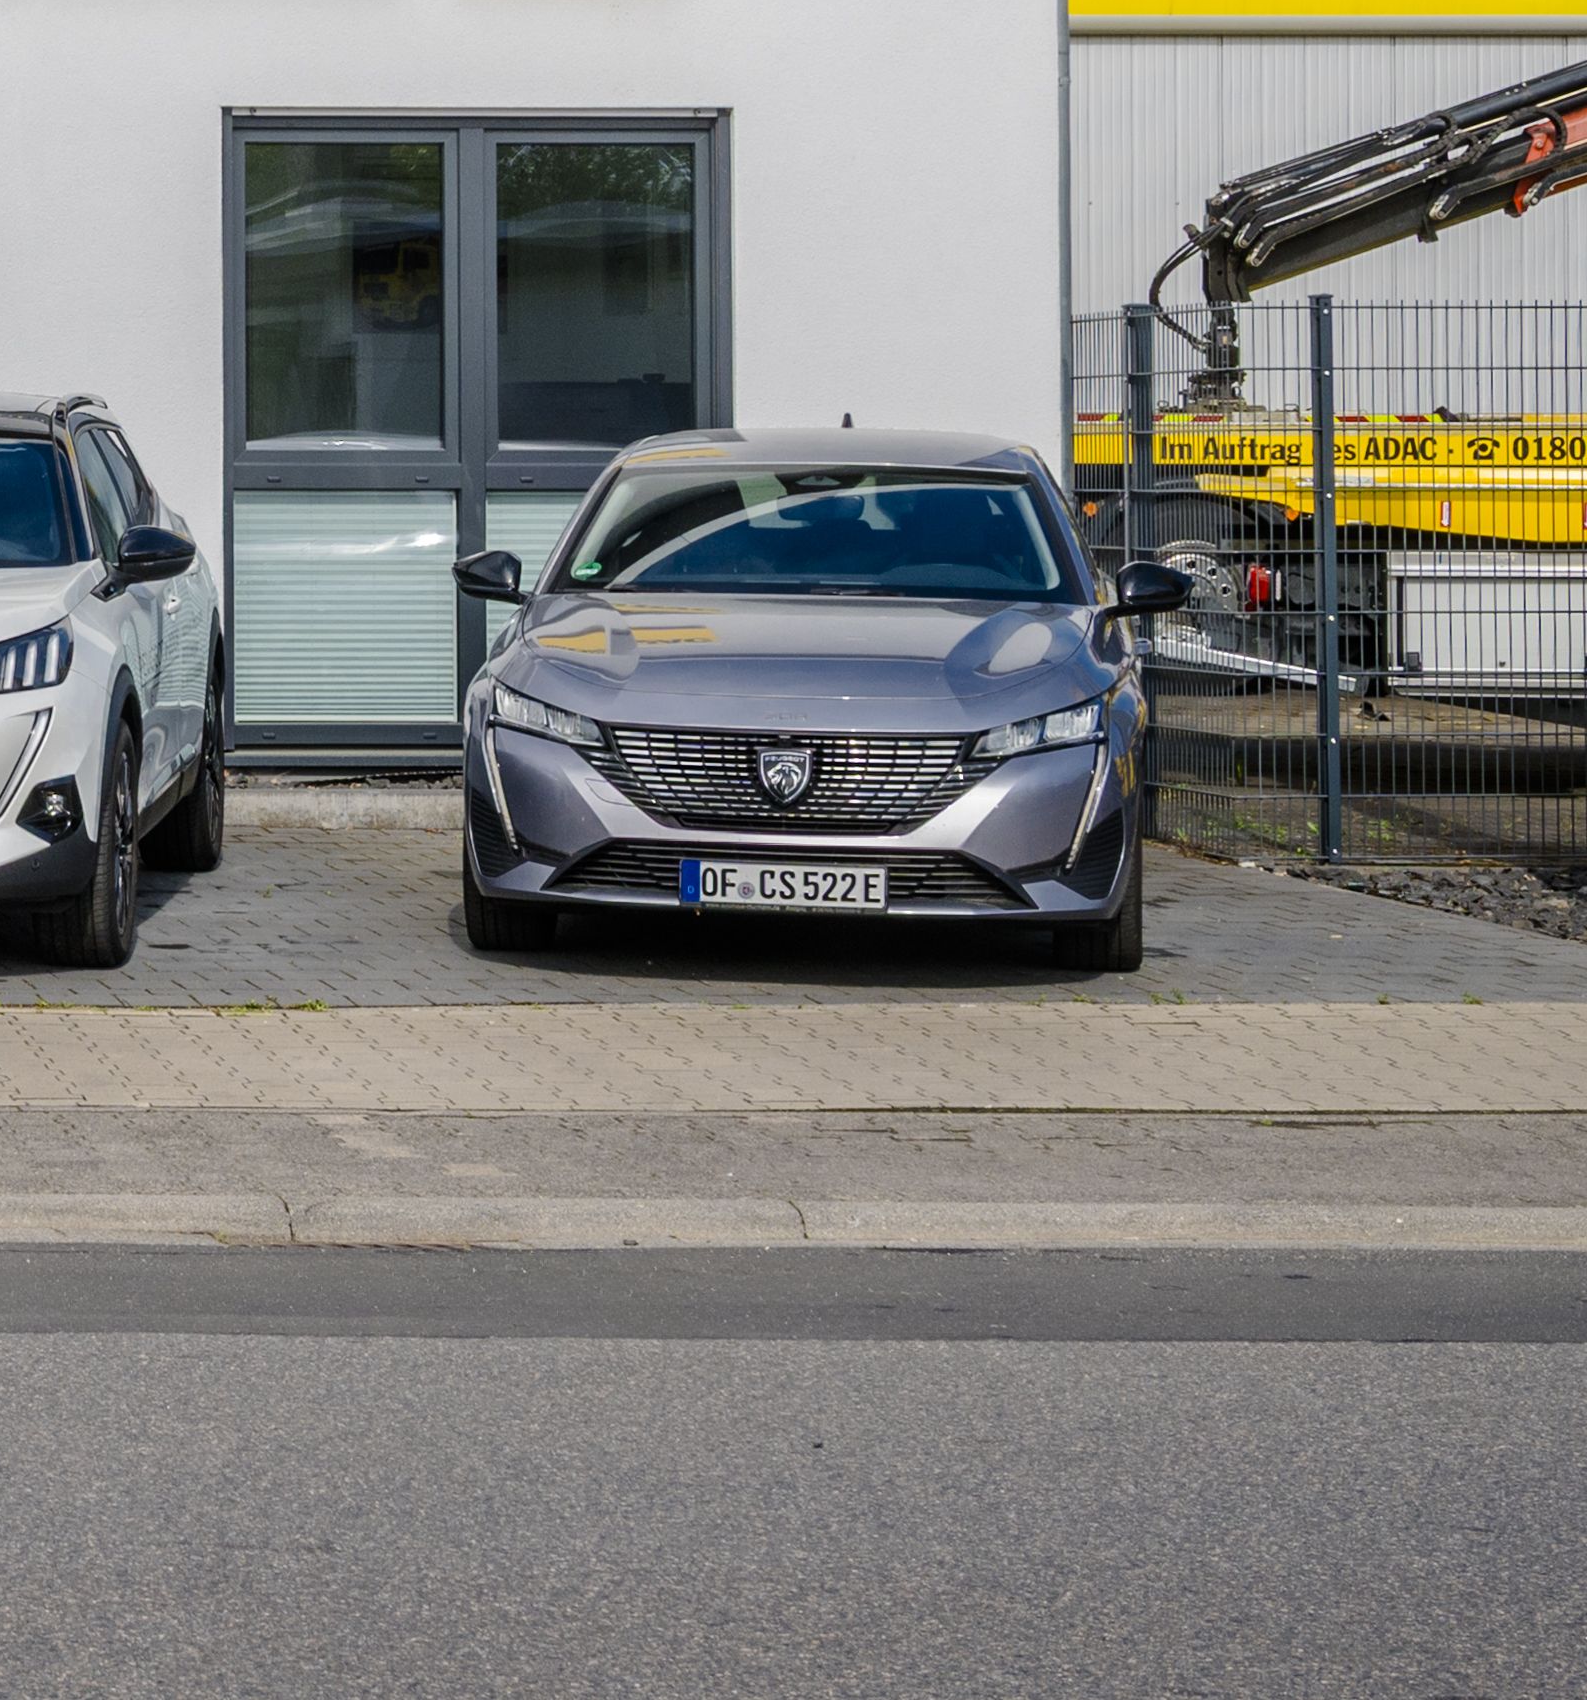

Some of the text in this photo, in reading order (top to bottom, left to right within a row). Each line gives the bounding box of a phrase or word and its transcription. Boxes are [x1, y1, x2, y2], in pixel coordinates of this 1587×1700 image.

[1160, 436, 1587, 465] Im Auftrag es ADAC 0180
[701, 867, 738, 897] OF
